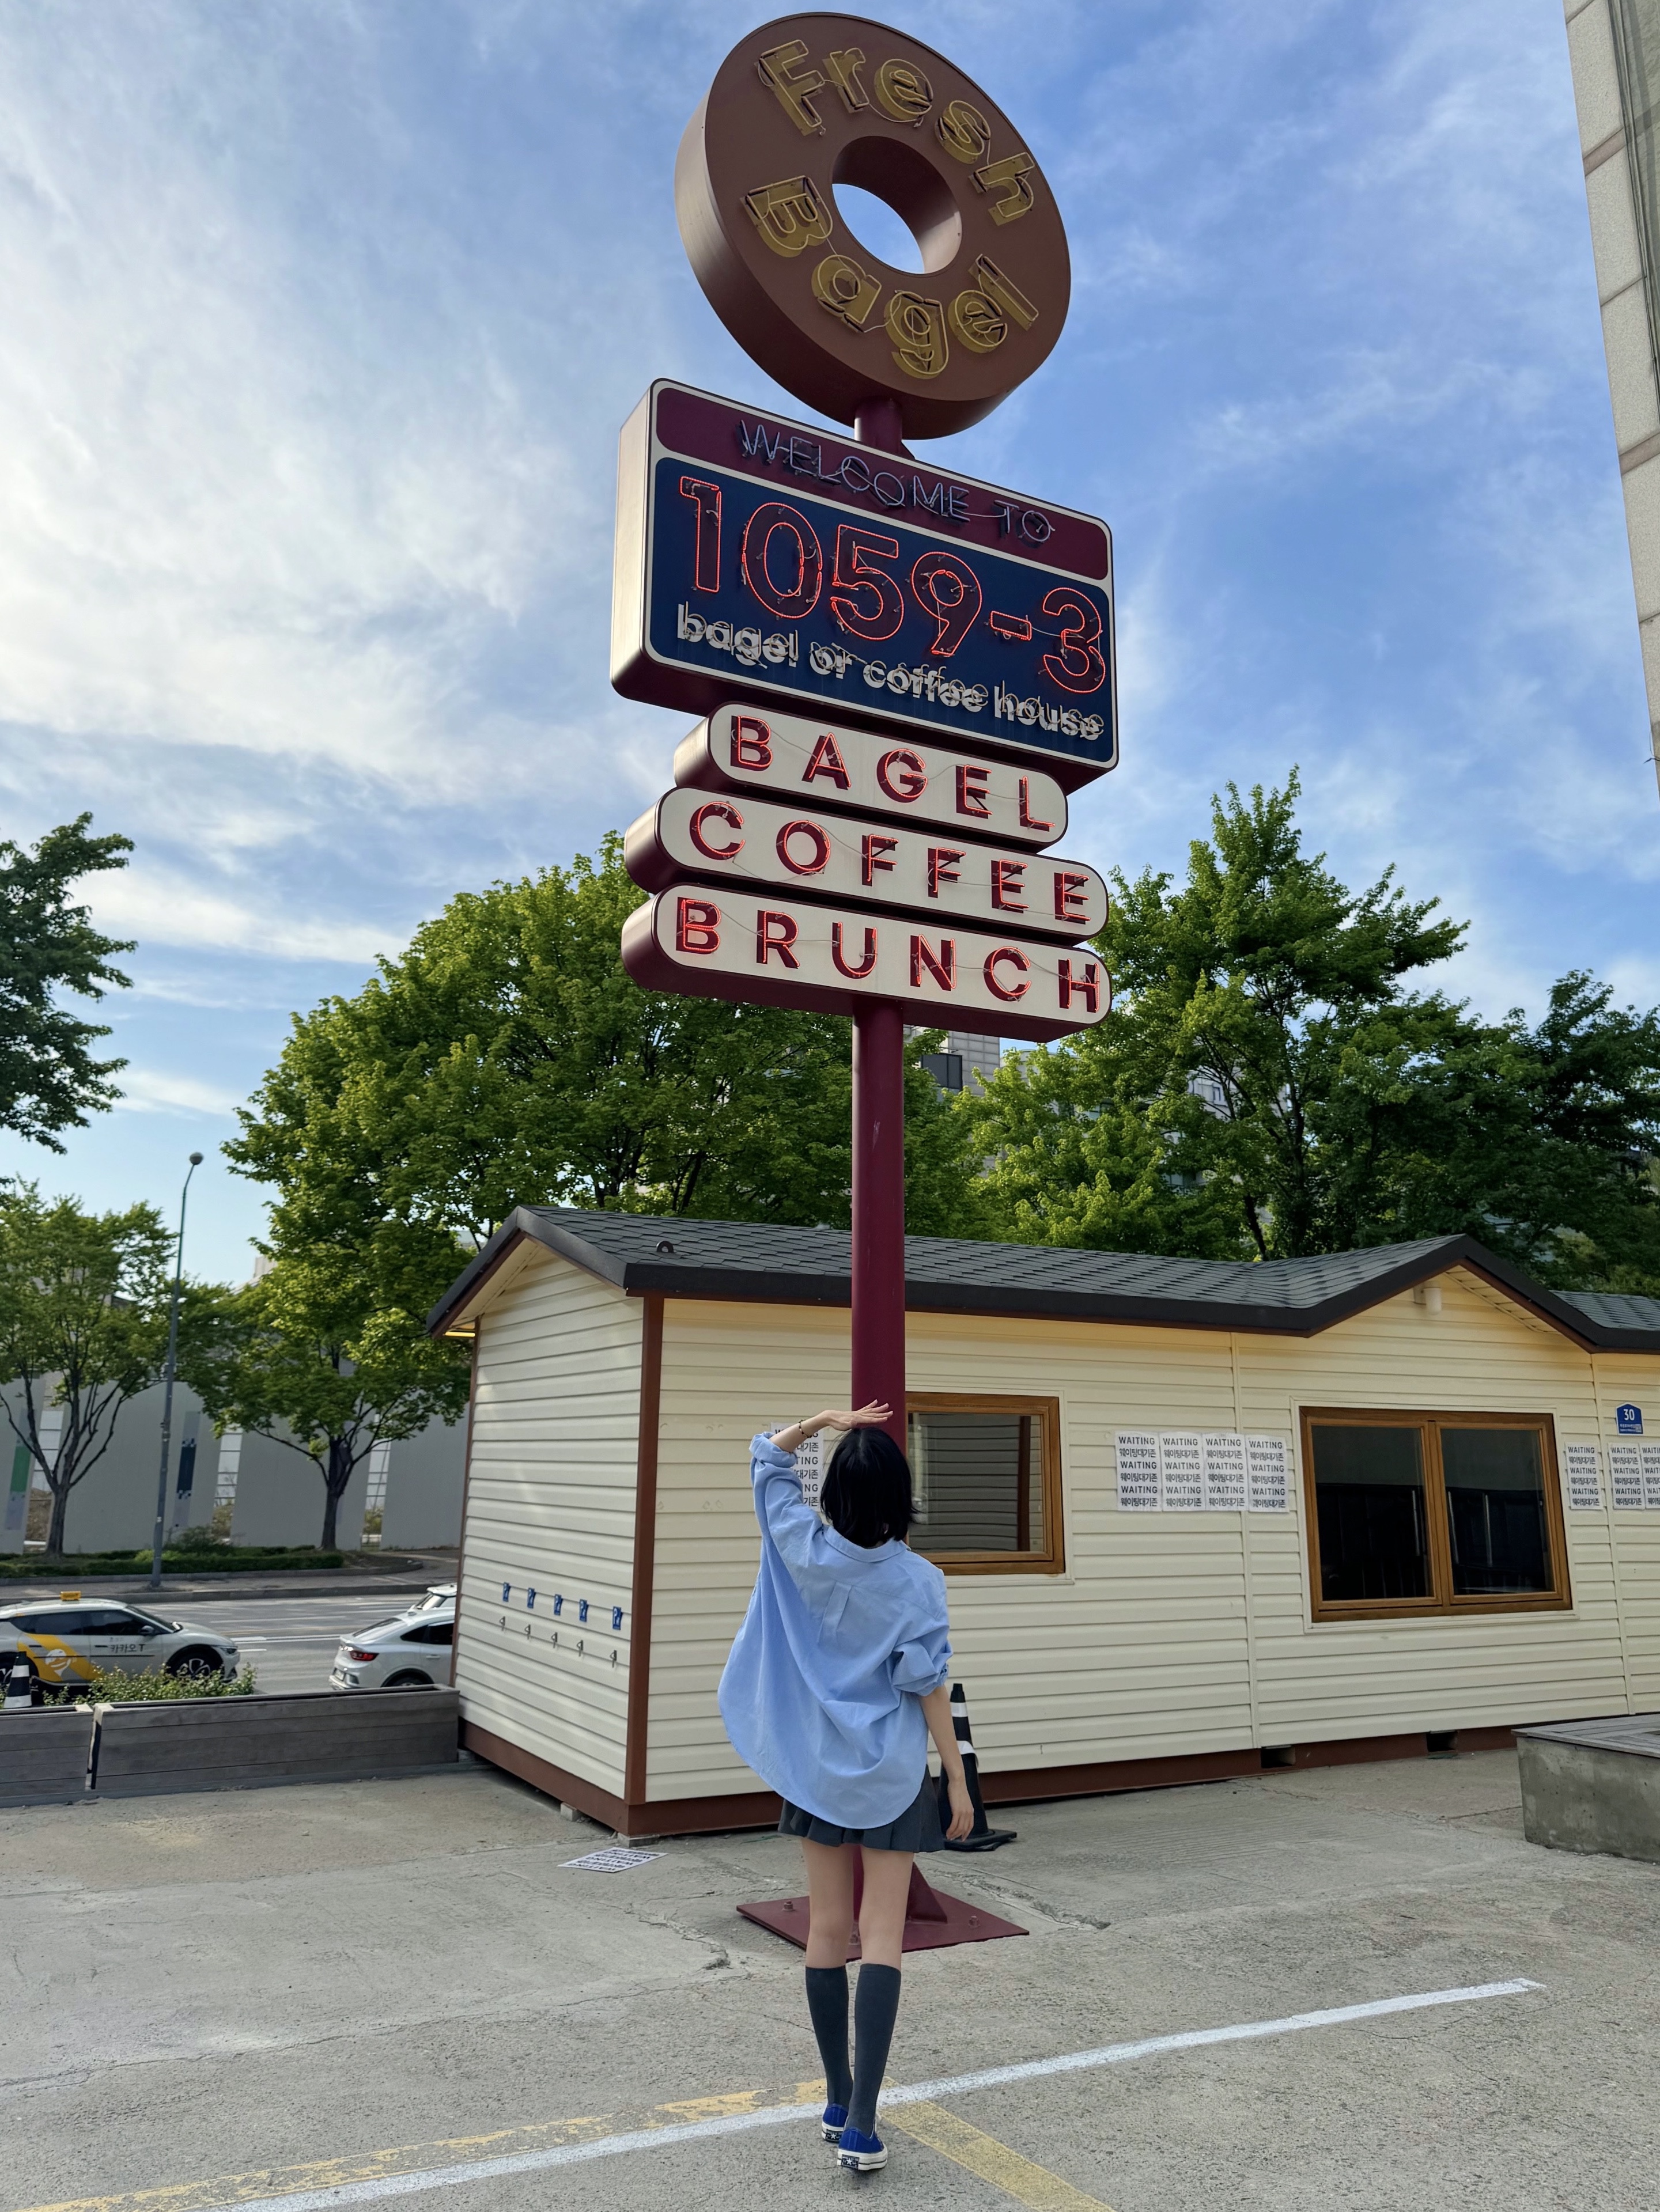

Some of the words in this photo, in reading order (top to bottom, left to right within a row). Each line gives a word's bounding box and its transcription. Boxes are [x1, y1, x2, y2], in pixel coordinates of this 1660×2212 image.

[754, 39, 1035, 226] Fresh
[743, 175, 1039, 380] Bagel
[736, 419, 971, 523] WELCOME
[993, 499, 1054, 550] TO
[679, 476, 1106, 694] 1059-3
[677, 601, 798, 668] bagel
[810, 642, 857, 679] or
[863, 660, 989, 713] coffee
[994, 680, 1104, 741] house
[730, 715, 1056, 832] BAGEL
[689, 800, 1091, 925] COFFEE
[676, 896, 1101, 1014] BRUNCH
[1623, 1408, 1635, 1421] 30
[1118, 1436, 1155, 1445] WAITING
[1163, 1438, 1198, 1446] WAITING
[1205, 1438, 1241, 1446] WAITING
[1249, 1441, 1283, 1449] WAITING
[796, 1457, 818, 1465] TING
[1120, 1461, 1157, 1469] WAITING
[1207, 1462, 1243, 1470] WAITING
[1251, 1464, 1284, 1472] WAITING
[1121, 1486, 1158, 1494] WAITING
